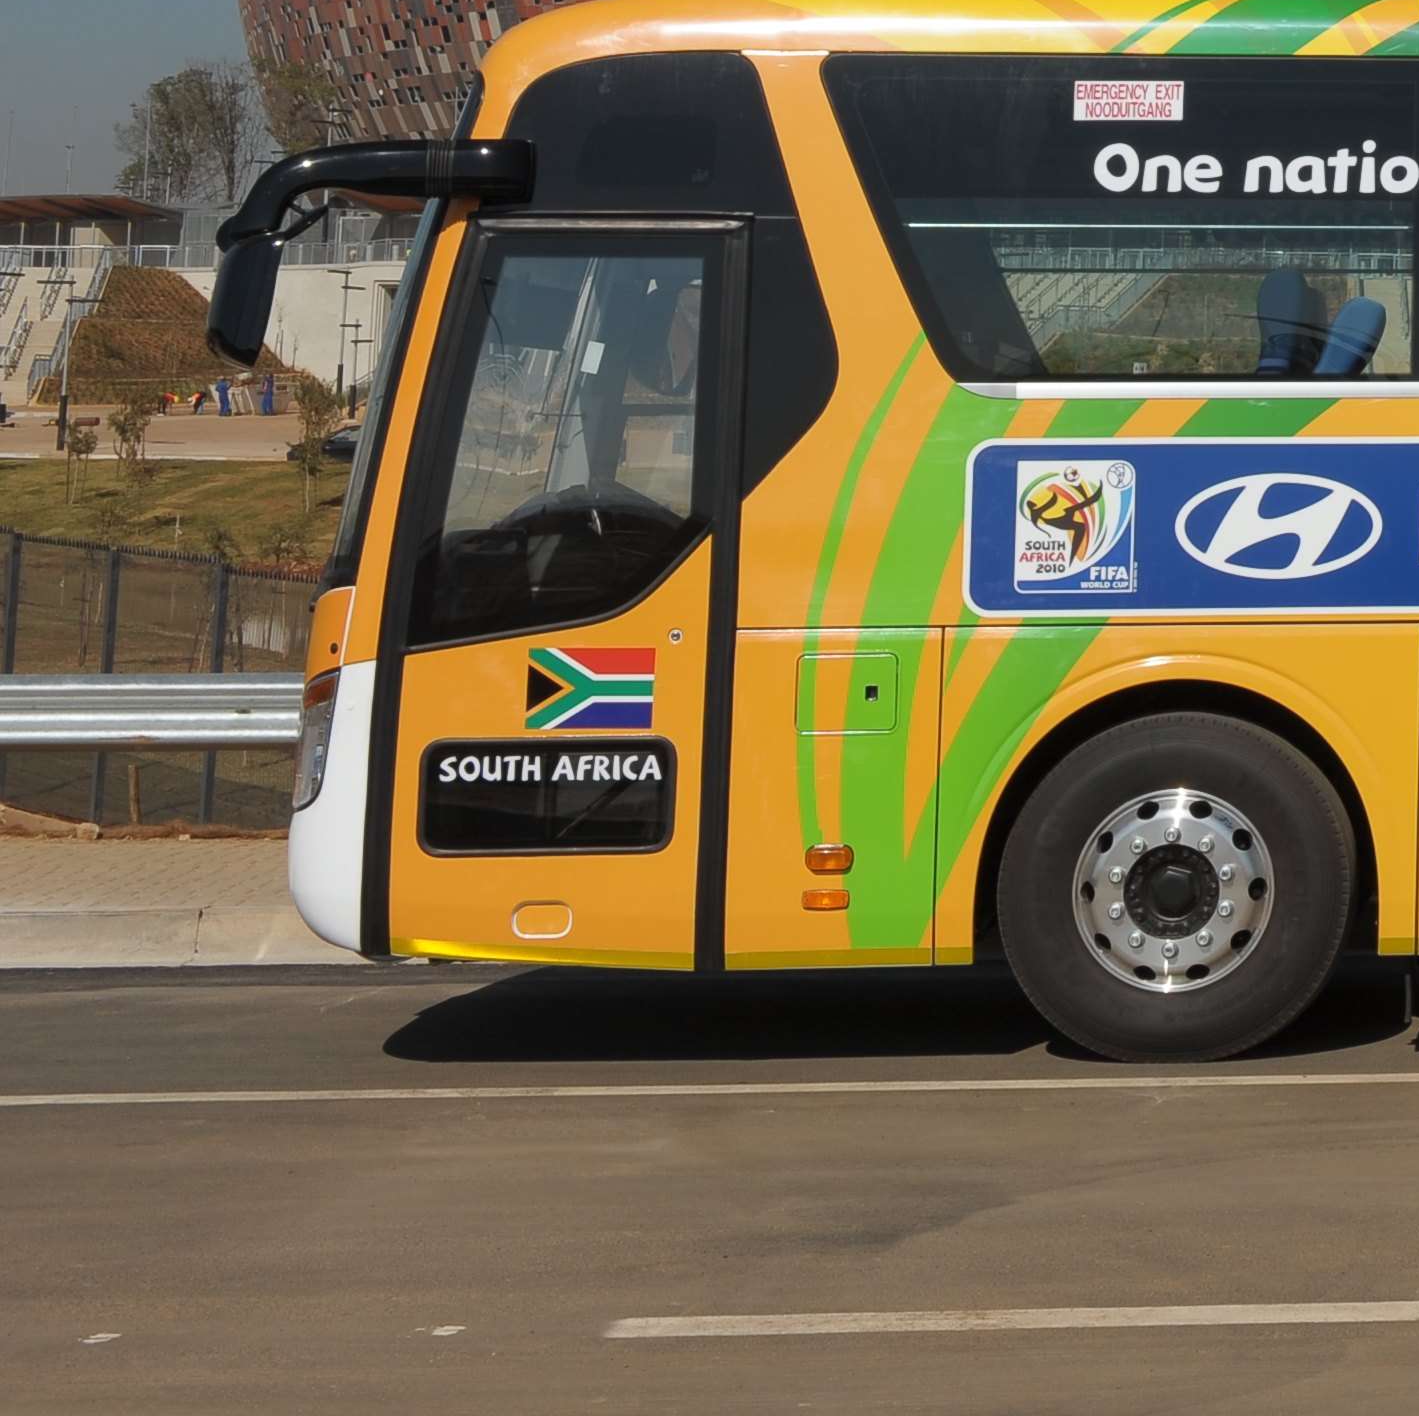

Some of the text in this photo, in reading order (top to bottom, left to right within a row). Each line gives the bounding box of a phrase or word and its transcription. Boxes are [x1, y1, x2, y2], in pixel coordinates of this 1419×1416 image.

[1076, 84, 1182, 100] EMERGENCY EXIT
[1085, 102, 1172, 118] NOODUITGANG
[1093, 142, 1223, 194] One
[1025, 541, 1065, 551] SOUTH
[1019, 552, 1065, 562] AFRICA
[1035, 564, 1065, 573] 2010
[1089, 566, 1128, 580] FIFA
[438, 754, 663, 783] SOUTH AFRICA
